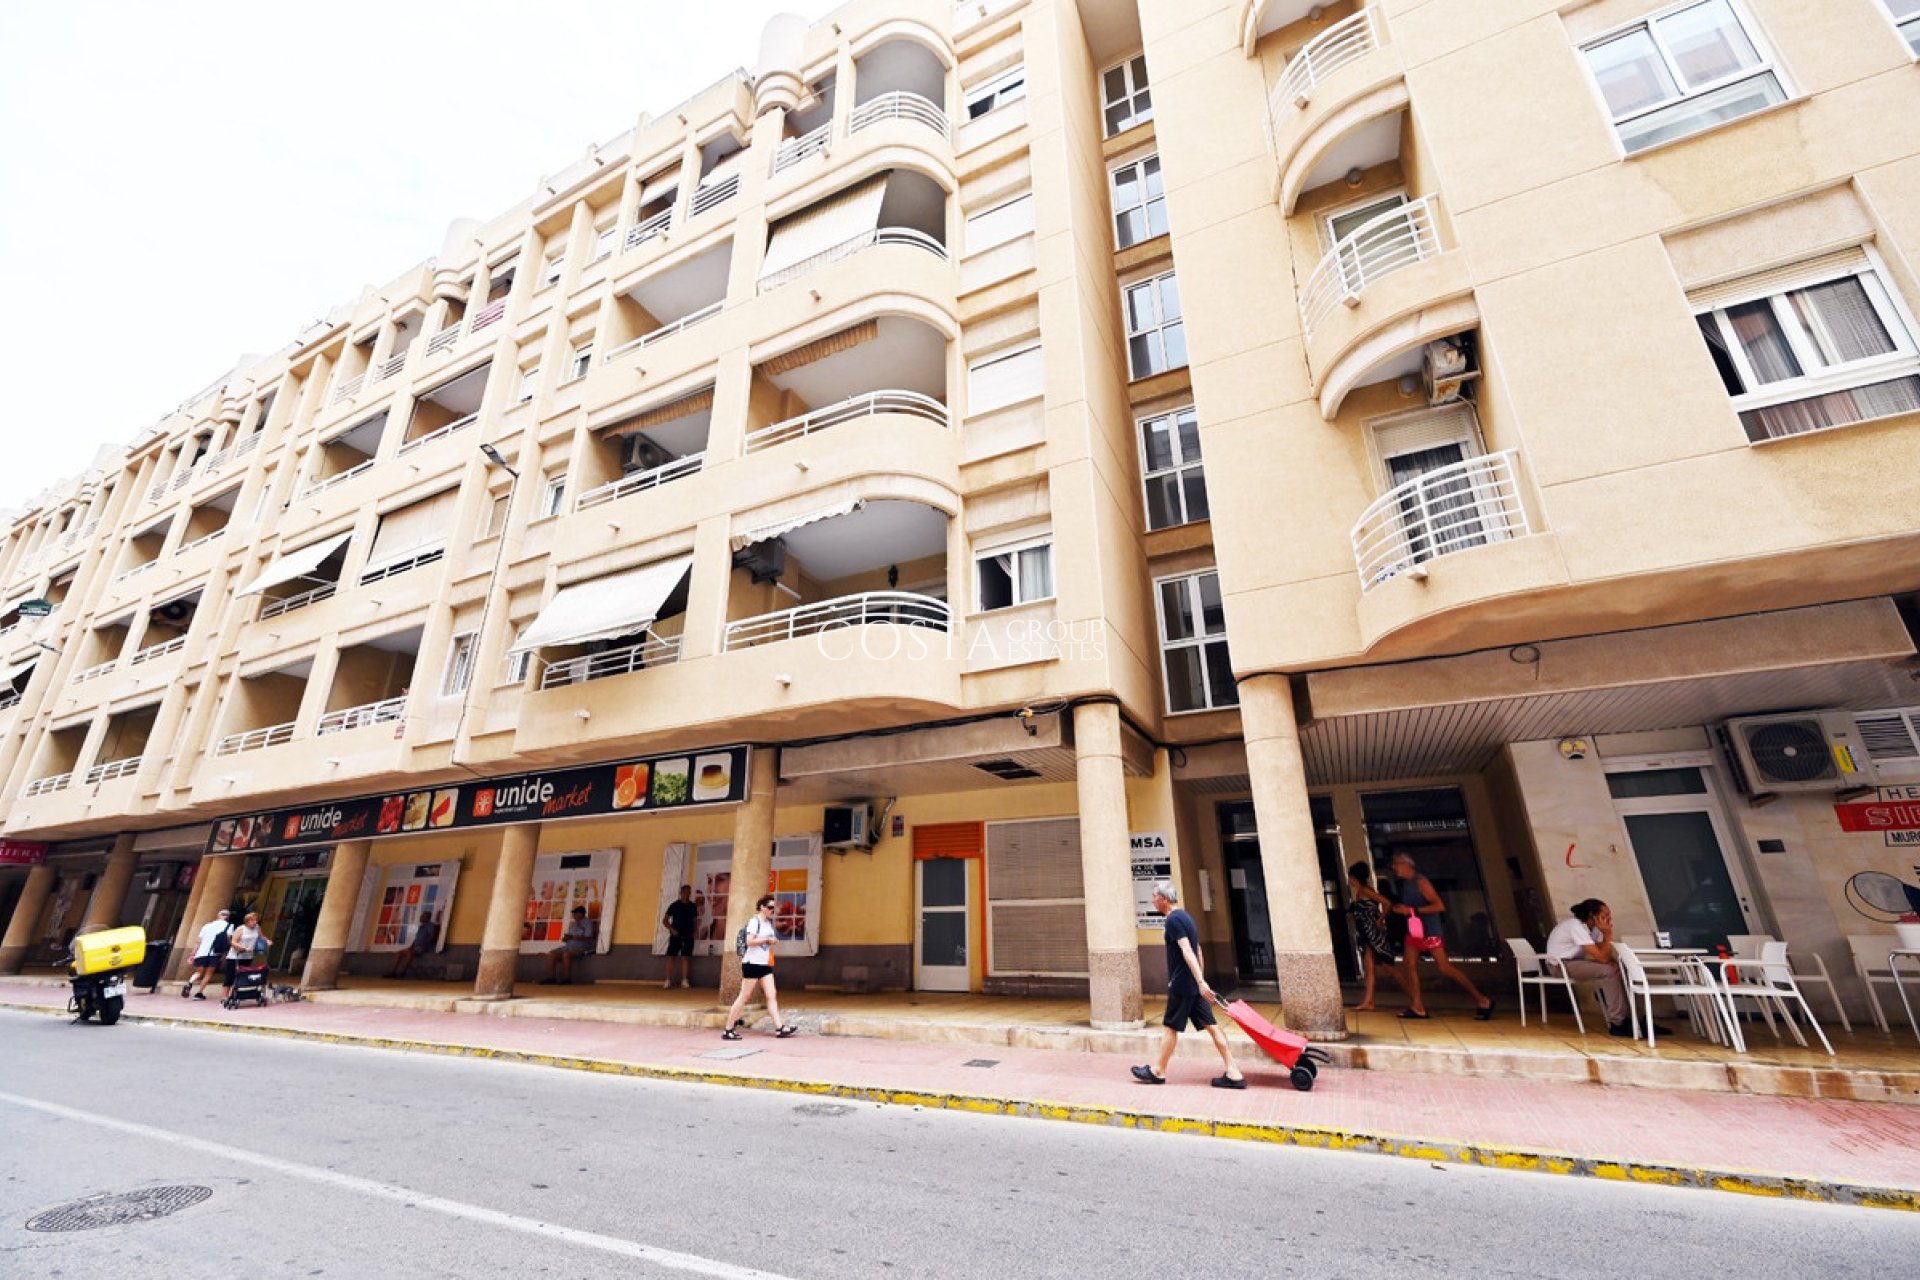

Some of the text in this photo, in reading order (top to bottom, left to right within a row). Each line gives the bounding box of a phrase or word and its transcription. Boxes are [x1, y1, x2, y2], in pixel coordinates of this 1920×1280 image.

[495, 778, 592, 815] unide market
[301, 806, 342, 831] unide
